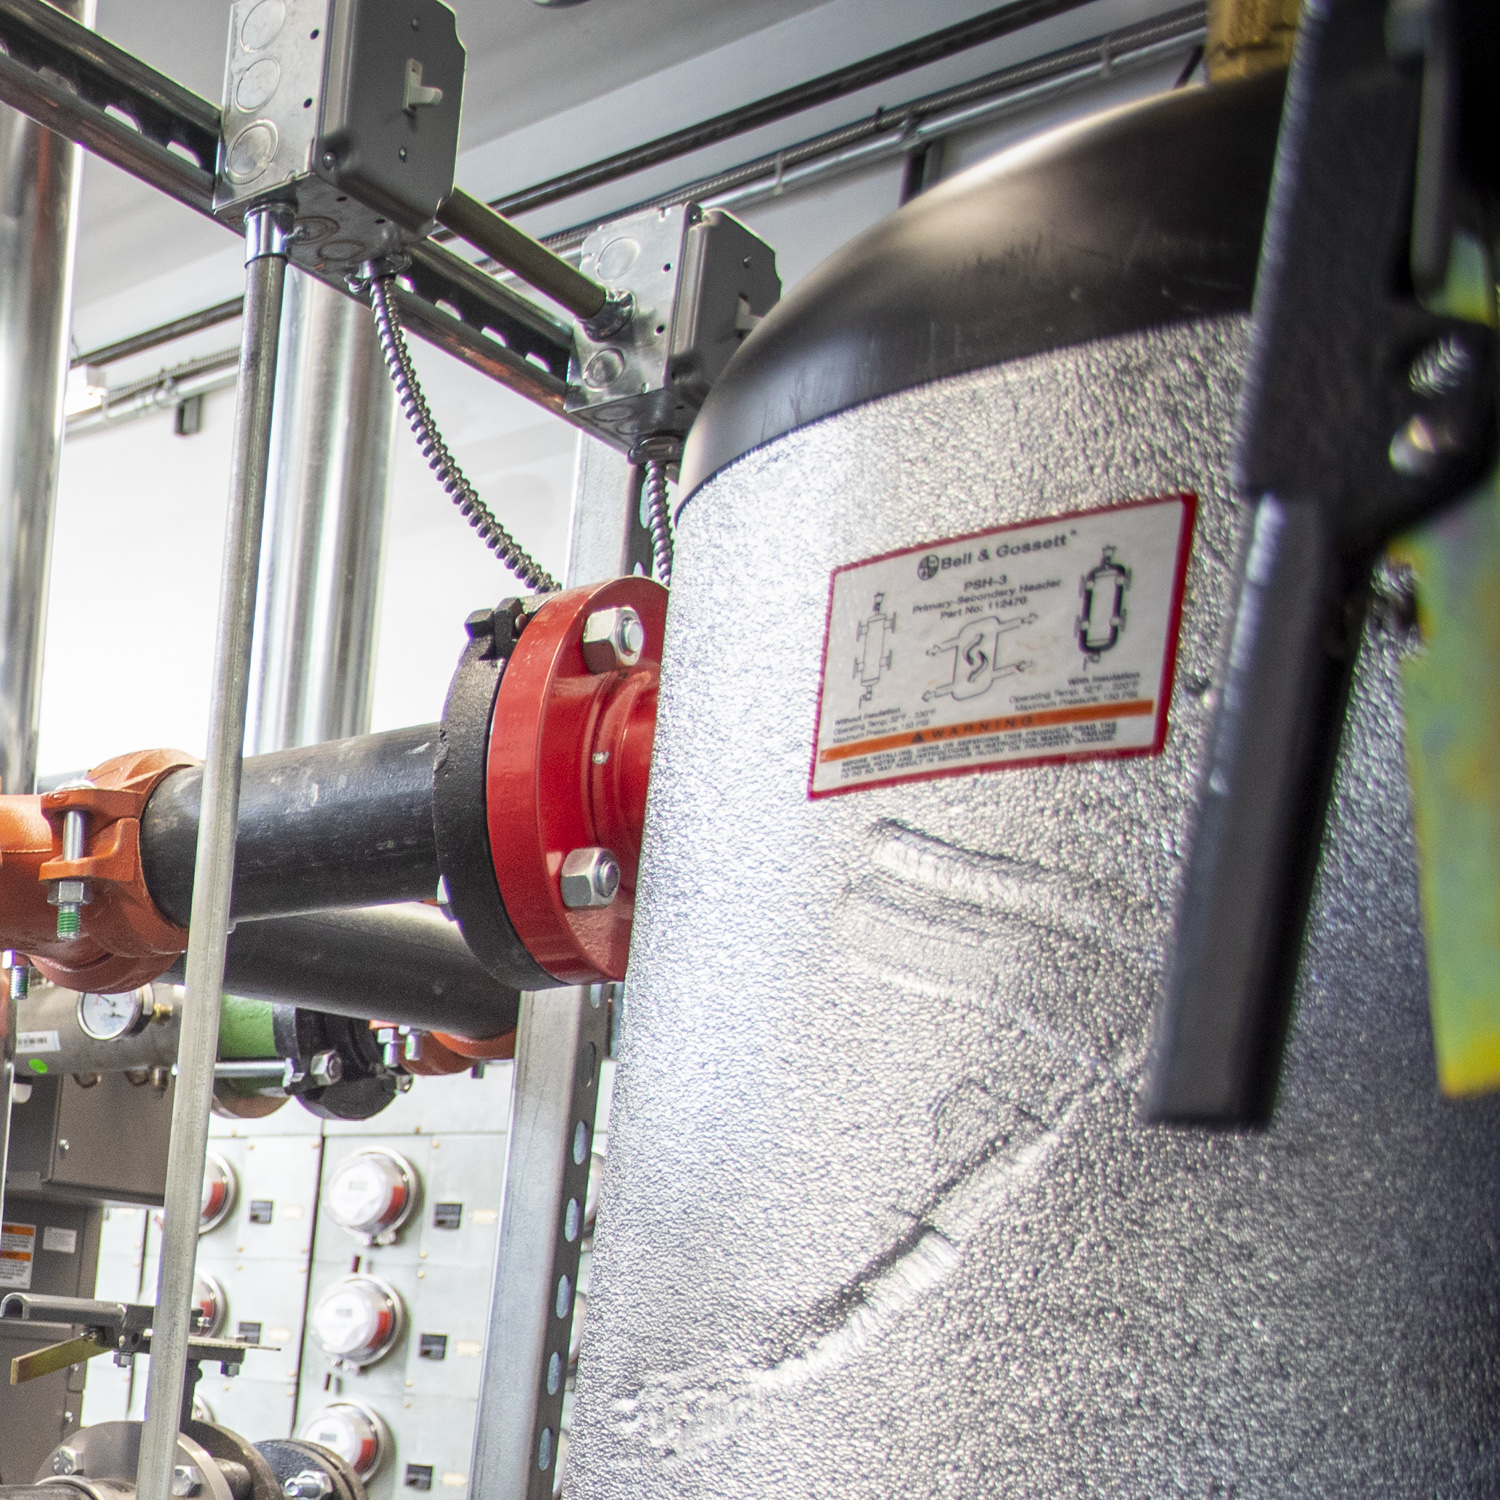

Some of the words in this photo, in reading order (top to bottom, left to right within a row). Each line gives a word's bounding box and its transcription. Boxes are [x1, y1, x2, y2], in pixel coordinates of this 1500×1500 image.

[941, 552, 972, 570] Bell
[978, 549, 990, 562] &
[996, 534, 1067, 558] Gossett
[964, 575, 1008, 592] PSH-3
[912, 587, 1016, 615] Primary-Secondary
[1019, 579, 1062, 593] Header
[940, 609, 962, 620] Part
[965, 604, 983, 614] No:
[988, 596, 1028, 610] 112470
[1068, 677, 1090, 686] With
[1091, 672, 1140, 682] Insulation
[1009, 692, 1051, 705] Operating
[1015, 700, 1056, 711] Maximum
[834, 715, 862, 726] Without
[864, 708, 901, 720] Insulation
[833, 724, 865, 736] Operating
[931, 716, 1033, 738] WARNING
[832, 733, 865, 744] Maximum
[841, 757, 867, 768] BEFORE
[917, 744, 940, 753] USING
[957, 735, 1000, 747] SERVICING
[1003, 731, 1022, 741] THIS
[938, 752, 972, 763] SERIOUS
